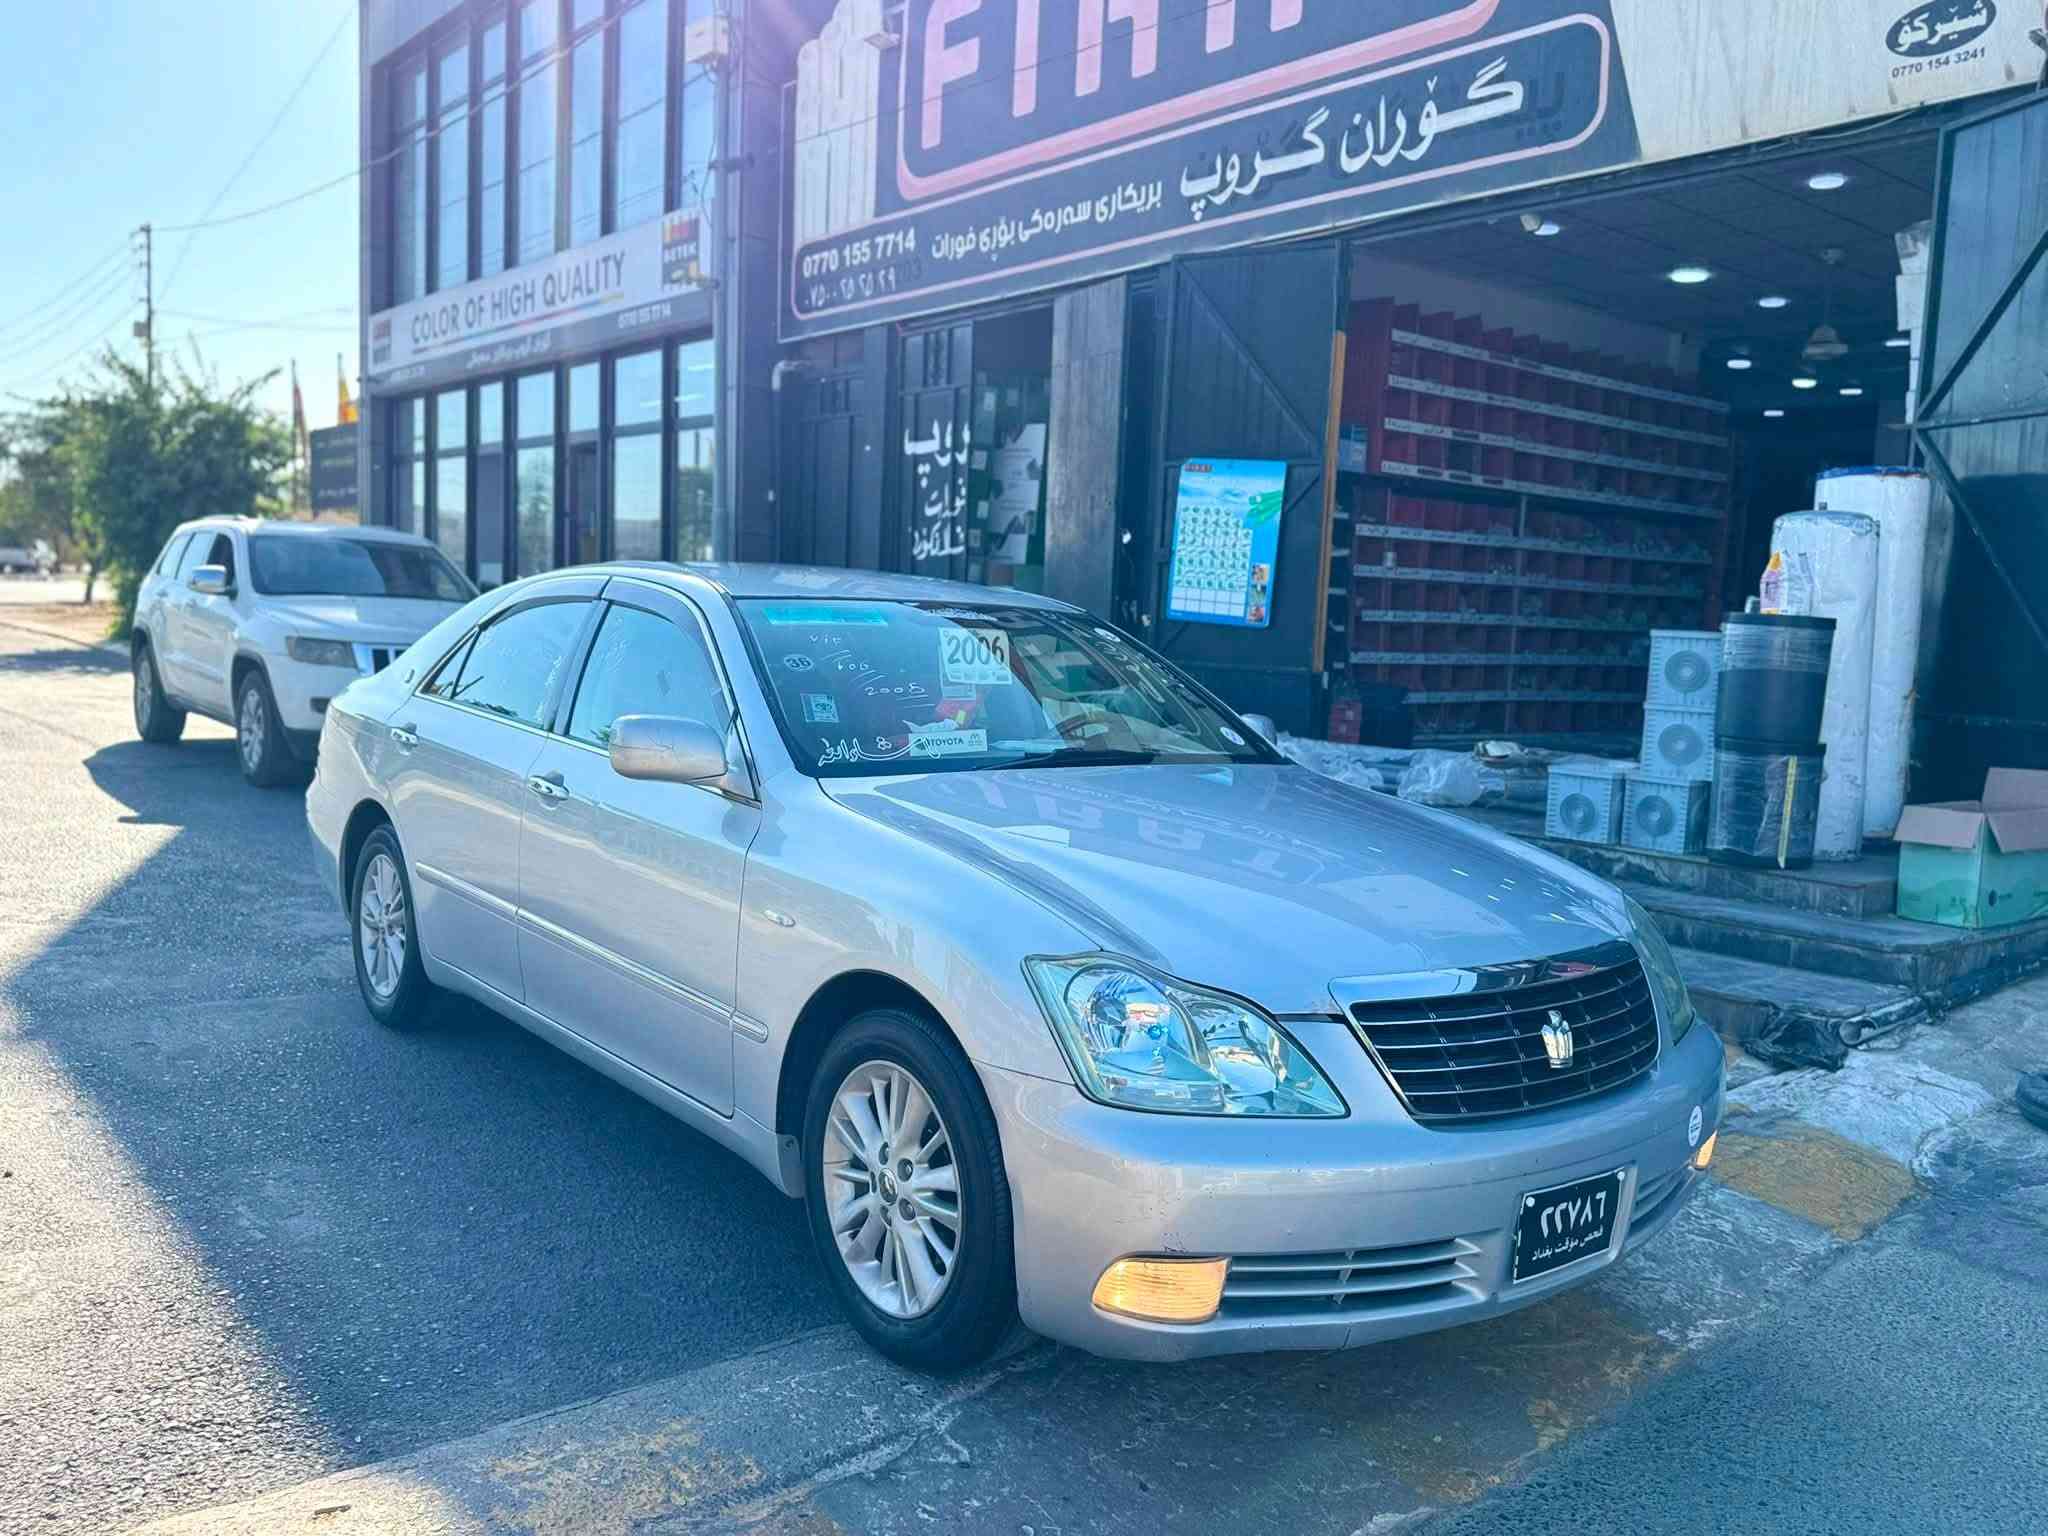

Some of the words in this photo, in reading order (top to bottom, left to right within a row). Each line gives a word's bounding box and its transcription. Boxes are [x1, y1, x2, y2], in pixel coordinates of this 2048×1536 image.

[1892, 64, 1923, 78] 0770
[1927, 58, 1950, 71] 154
[1955, 47, 1985, 63] 3241
[803, 248, 839, 278] 0770
[842, 239, 871, 268] 155
[874, 227, 915, 259] 7714
[411, 303, 460, 345] COLOR
[464, 297, 485, 331] OF
[492, 284, 536, 323] HIGH
[542, 252, 625, 306] QUALITY
[947, 636, 1005, 665] 2006
